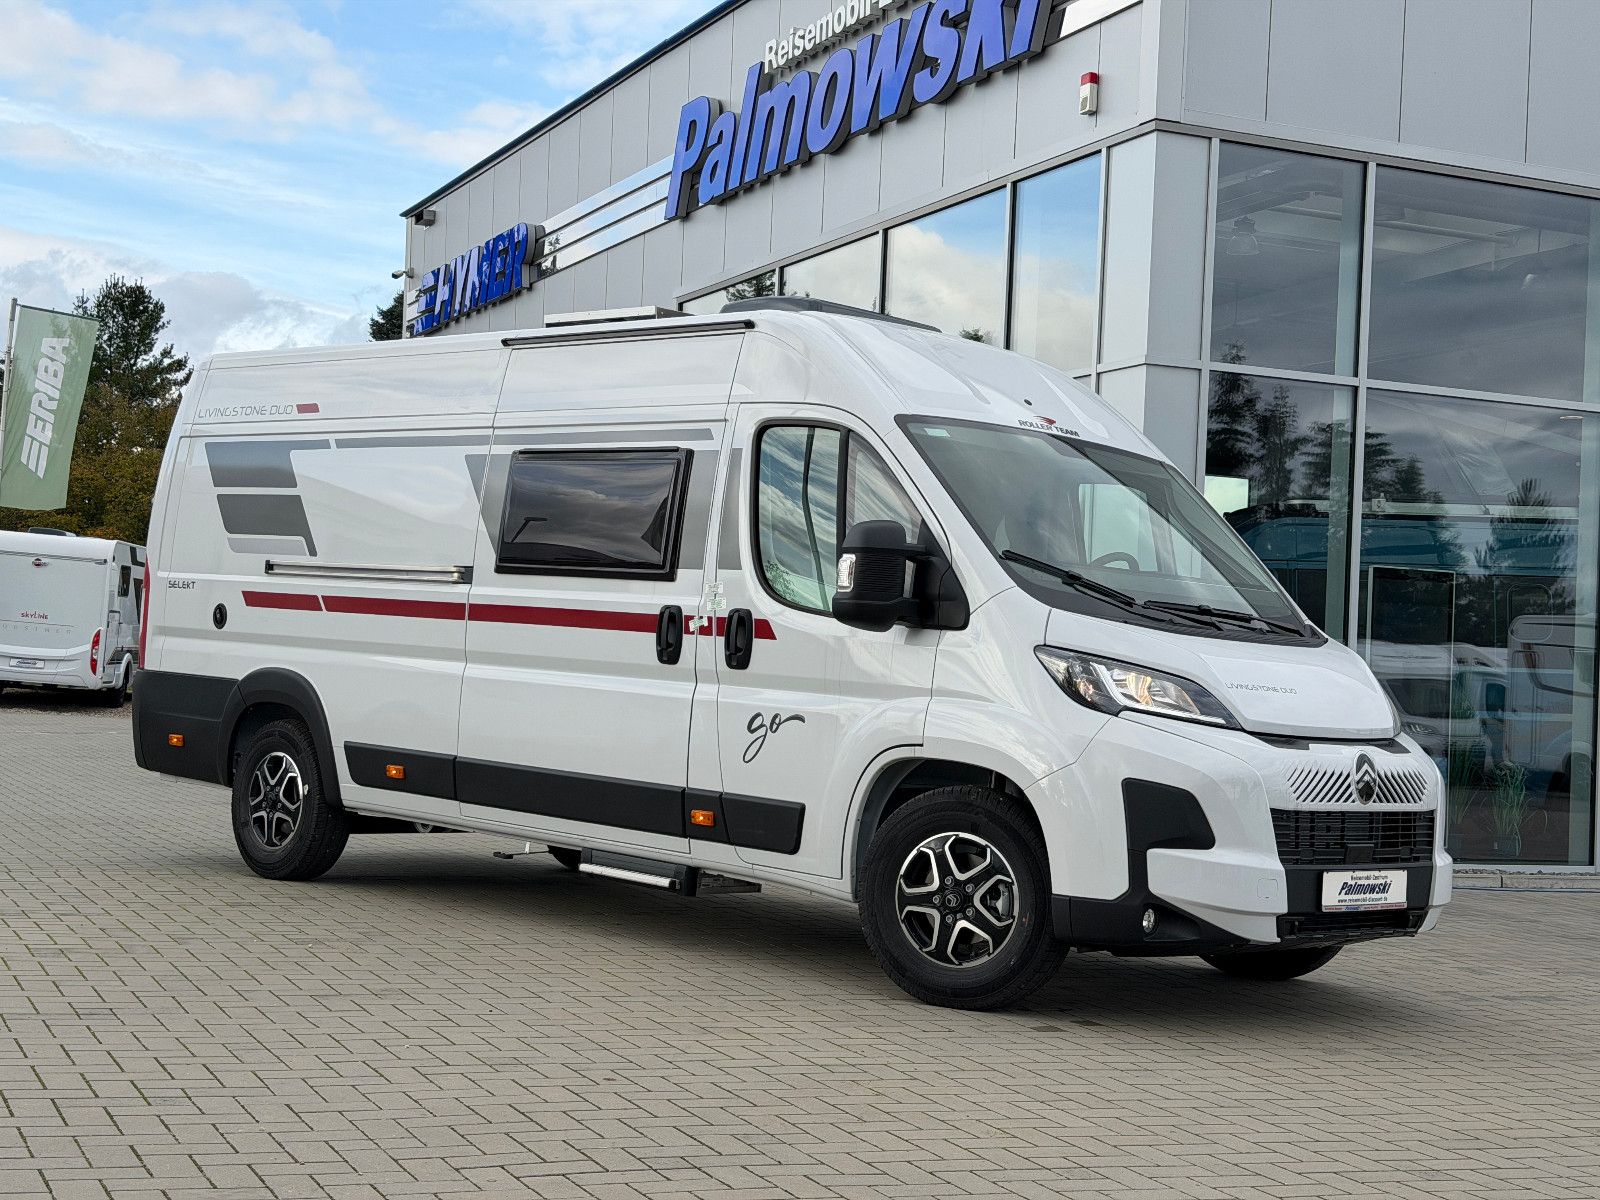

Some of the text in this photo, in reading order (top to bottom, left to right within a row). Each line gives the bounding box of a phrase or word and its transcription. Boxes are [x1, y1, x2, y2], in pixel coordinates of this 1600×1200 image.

[433, 222, 530, 327] HYMER
[26, 337, 71, 446] ERIBA
[198, 404, 294, 418] LIVINGSTONE DUO
[1017, 419, 1080, 437] ROLLER TEAM
[168, 580, 196, 589] SELEKT
[1225, 682, 1297, 695] LIVINGSTONE DUO
[743, 712, 805, 763] go
[1338, 880, 1393, 896] Palmowski
